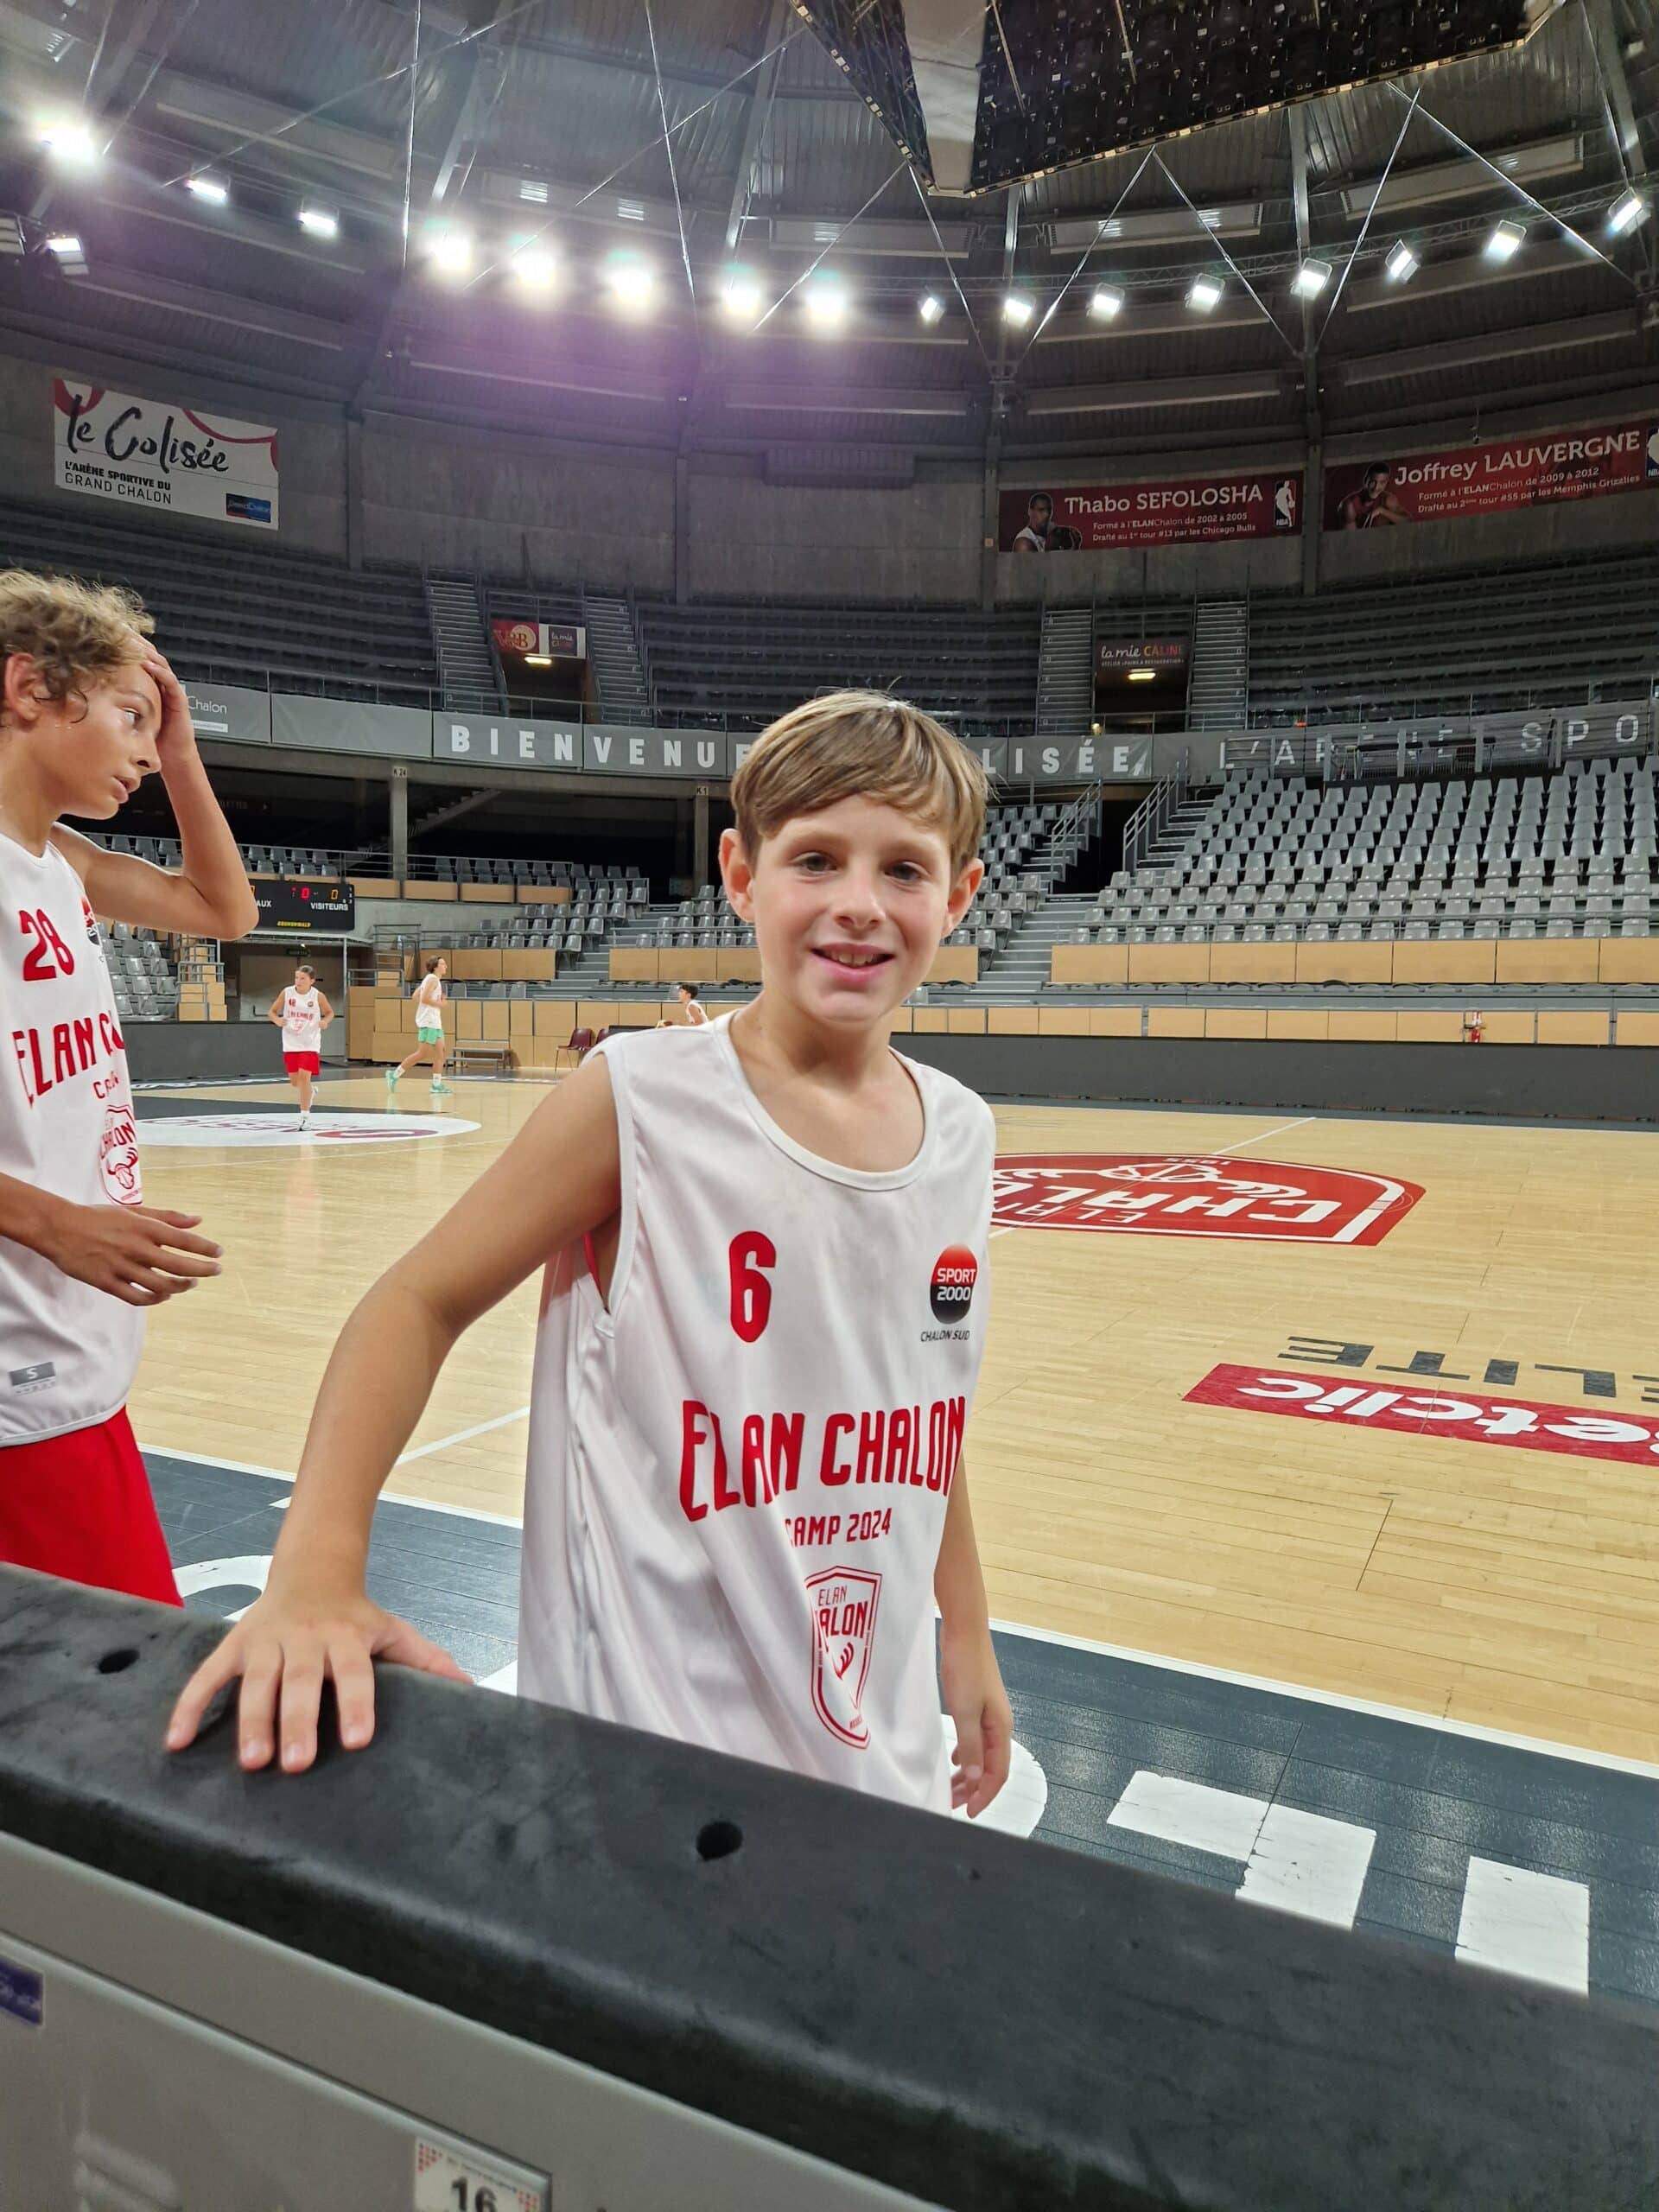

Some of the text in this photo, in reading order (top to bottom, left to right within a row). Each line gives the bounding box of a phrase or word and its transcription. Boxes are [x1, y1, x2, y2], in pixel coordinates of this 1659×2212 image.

[105, 407, 229, 474] Colisée
[1395, 431, 1640, 486] Joffrey LAUVERGNE
[107, 469, 155, 488] SPORTIVE
[158, 480, 171, 491] DU
[1540, 473, 1565, 483] 2009
[1574, 467, 1599, 478] 2012
[1648, 468, 1659, 477] NB
[65, 473, 172, 505] GRAND CHALON
[1064, 484, 1264, 514] Thabo SEFOLOSHA
[1521, 492, 1535, 500] par
[1174, 530, 1187, 538] par
[1202, 525, 1235, 535] Chicago
[1101, 645, 1114, 658] la
[1116, 645, 1141, 657] mie
[331, 889, 340, 899] 0
[310, 902, 349, 912] VISITEURS
[18, 908, 75, 982] 28
[937, 1268, 976, 1283] SPORT
[728, 1230, 777, 1343] 6
[937, 1286, 971, 1301] 2000
[920, 1330, 970, 1342] CHALON SUD
[1236, 1377, 1659, 1452] etclic
[679, 1395, 966, 1522] ELAN CHALON
[846, 1508, 893, 1542] 2024
[817, 1585, 848, 1606] ELAN
[451, 2176, 498, 2212] 16
